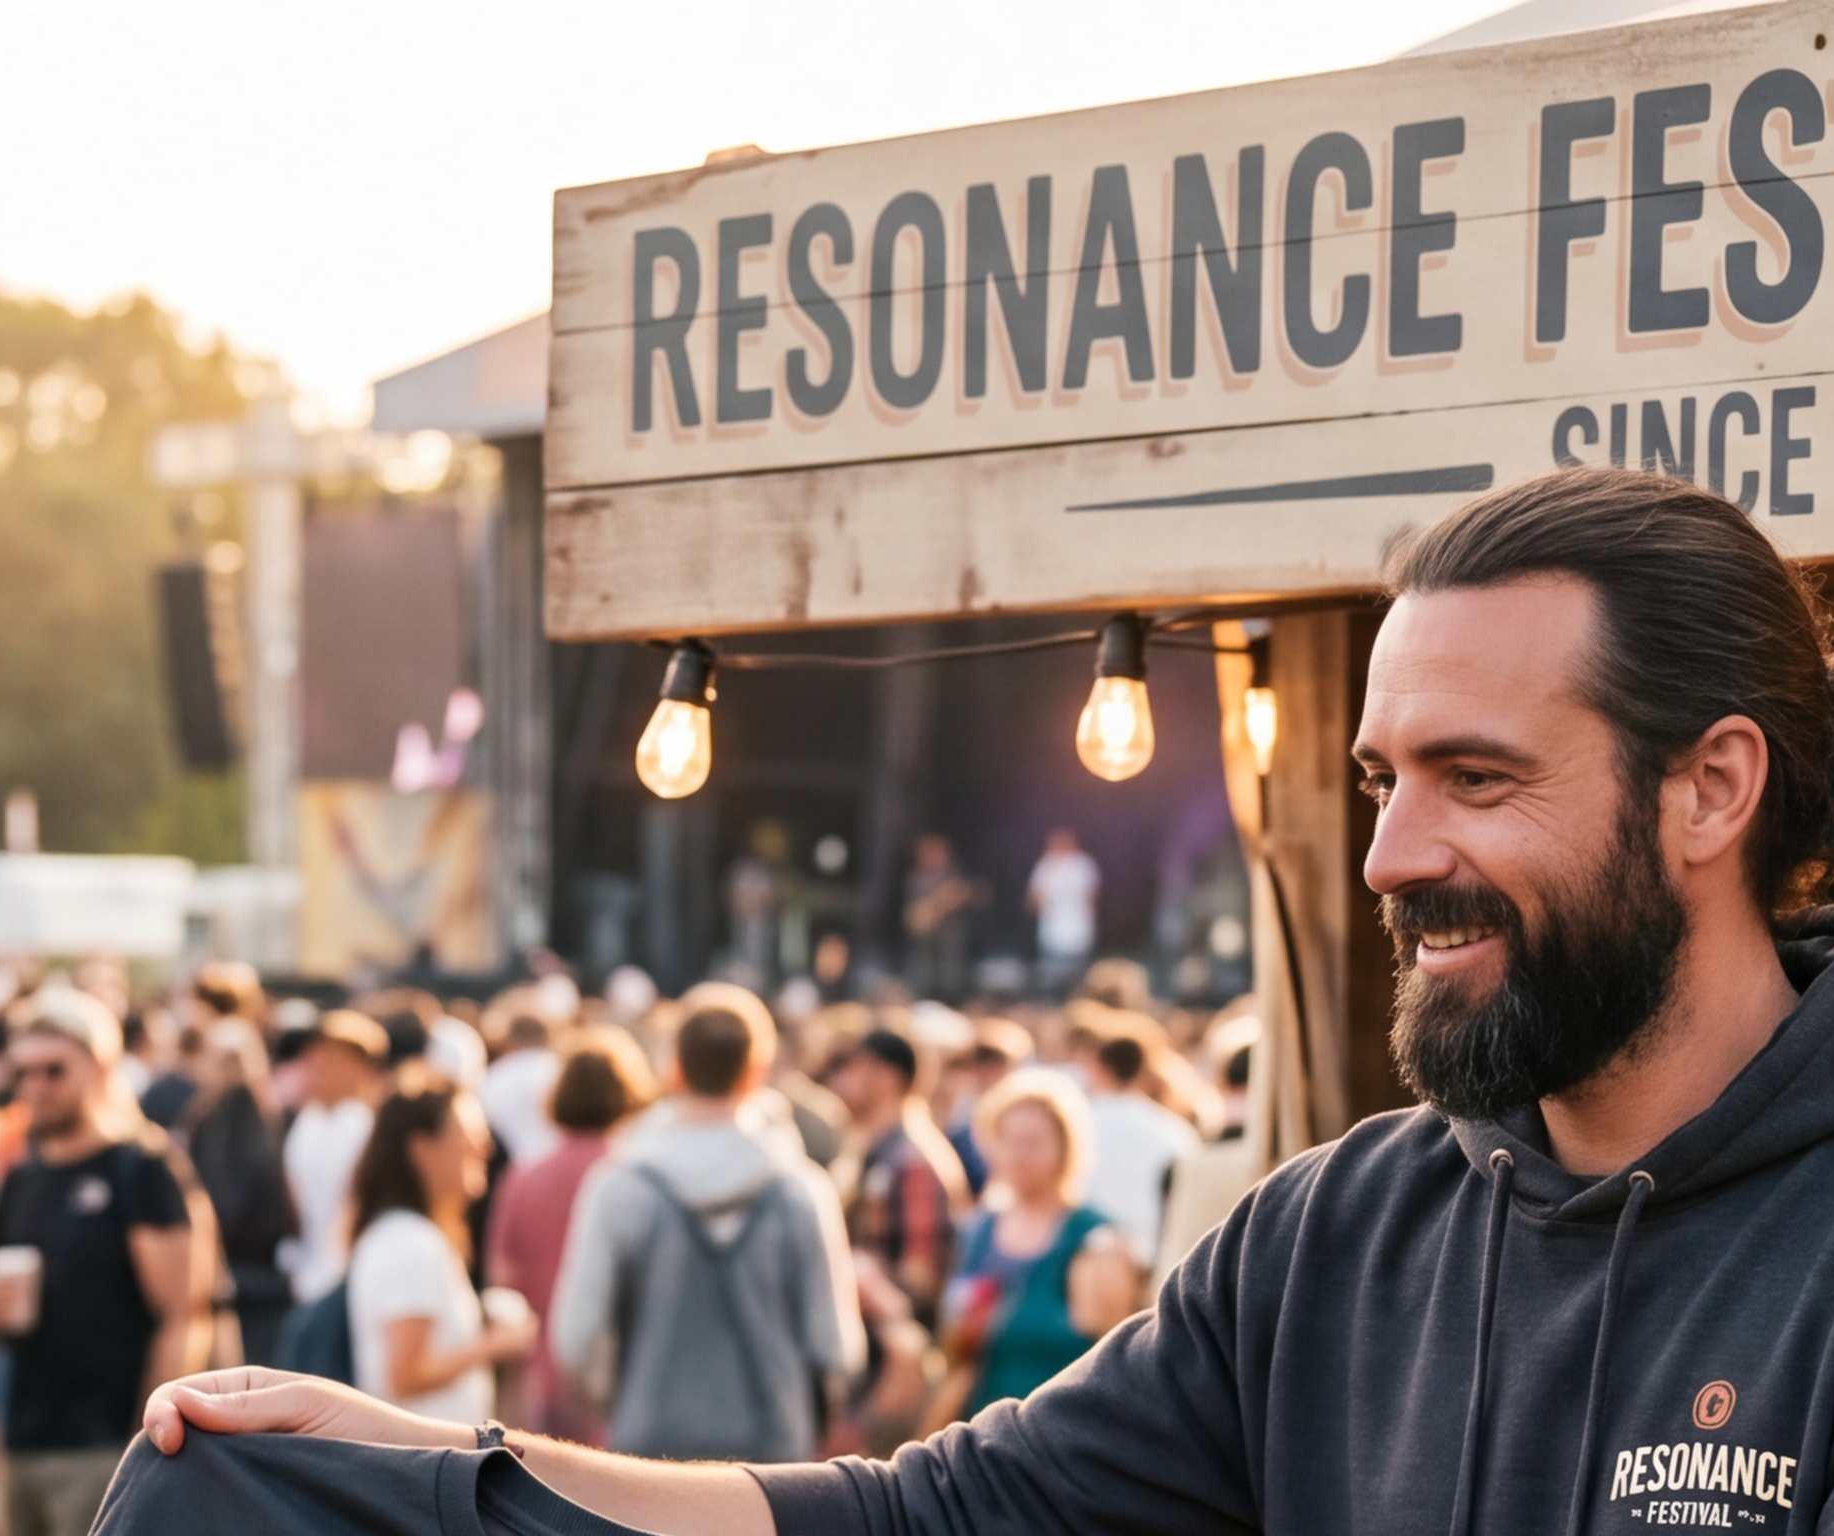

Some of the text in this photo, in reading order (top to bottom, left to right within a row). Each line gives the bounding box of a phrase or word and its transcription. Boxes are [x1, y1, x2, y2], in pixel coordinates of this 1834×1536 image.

[629, 114, 1467, 434] RESONANCE
[1610, 1442, 1797, 1509] RESONANCE
[1646, 1501, 1732, 1527] FESTIVAL
